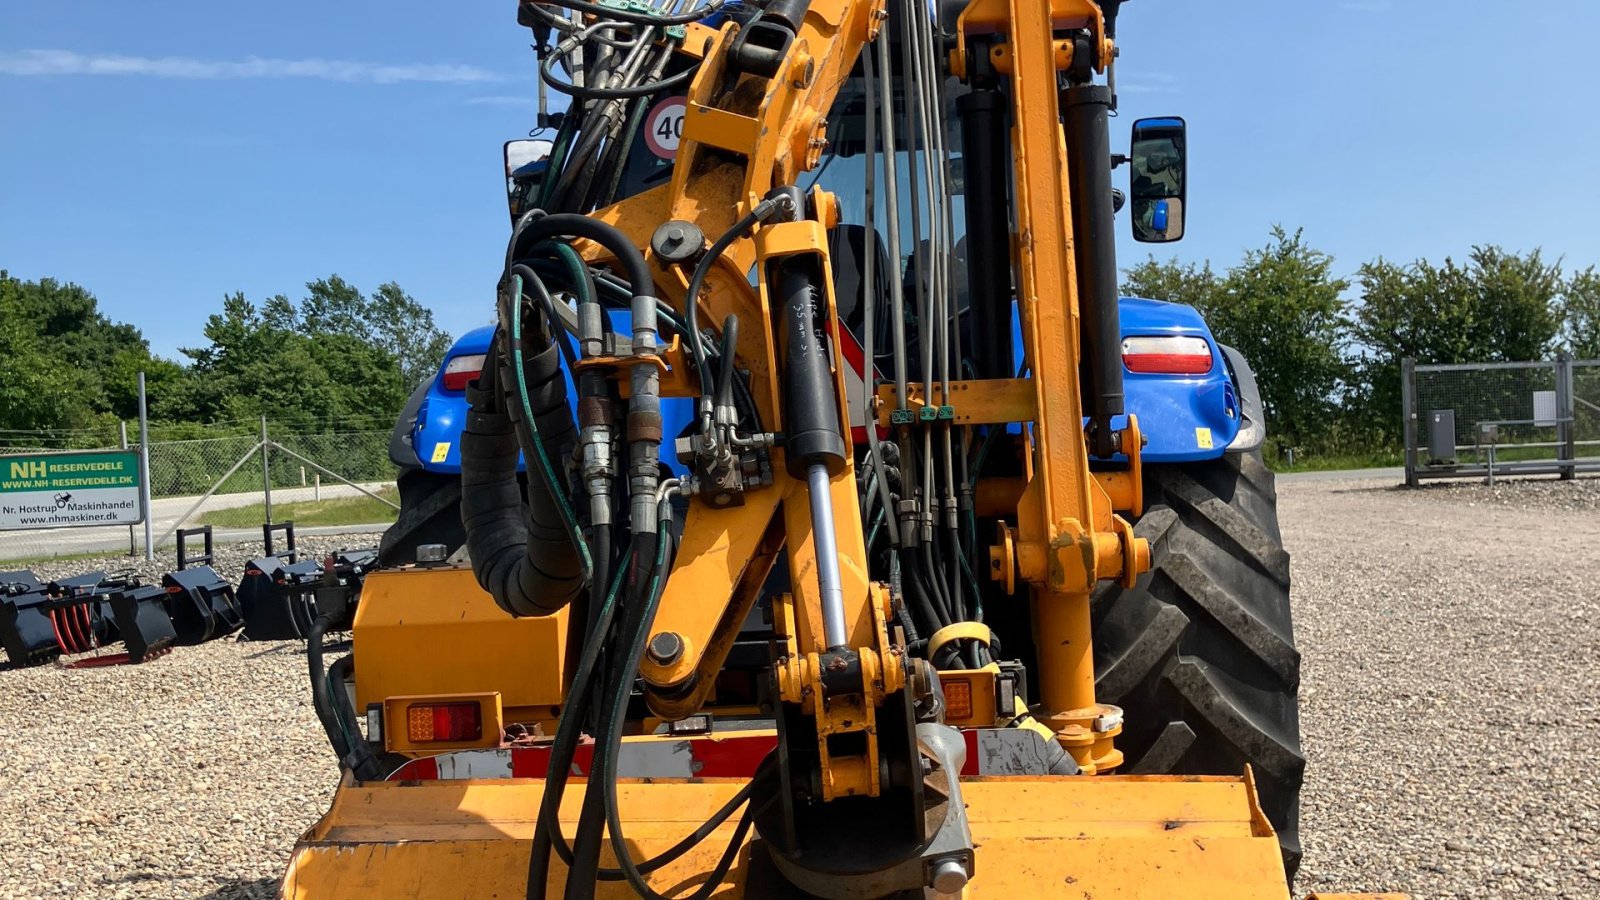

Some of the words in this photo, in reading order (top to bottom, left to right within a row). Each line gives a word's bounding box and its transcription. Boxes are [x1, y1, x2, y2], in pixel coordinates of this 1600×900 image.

[11, 462, 46, 478] NH
[50, 462, 123, 472] RESERVEDELE
[2, 476, 132, 488] WWW.NH-RESERVEDELE.DK
[19, 505, 57, 514] Hostrup
[67, 500, 134, 511] Maskinhandel
[20, 512, 117, 524] www.nhmaskiner.dk
